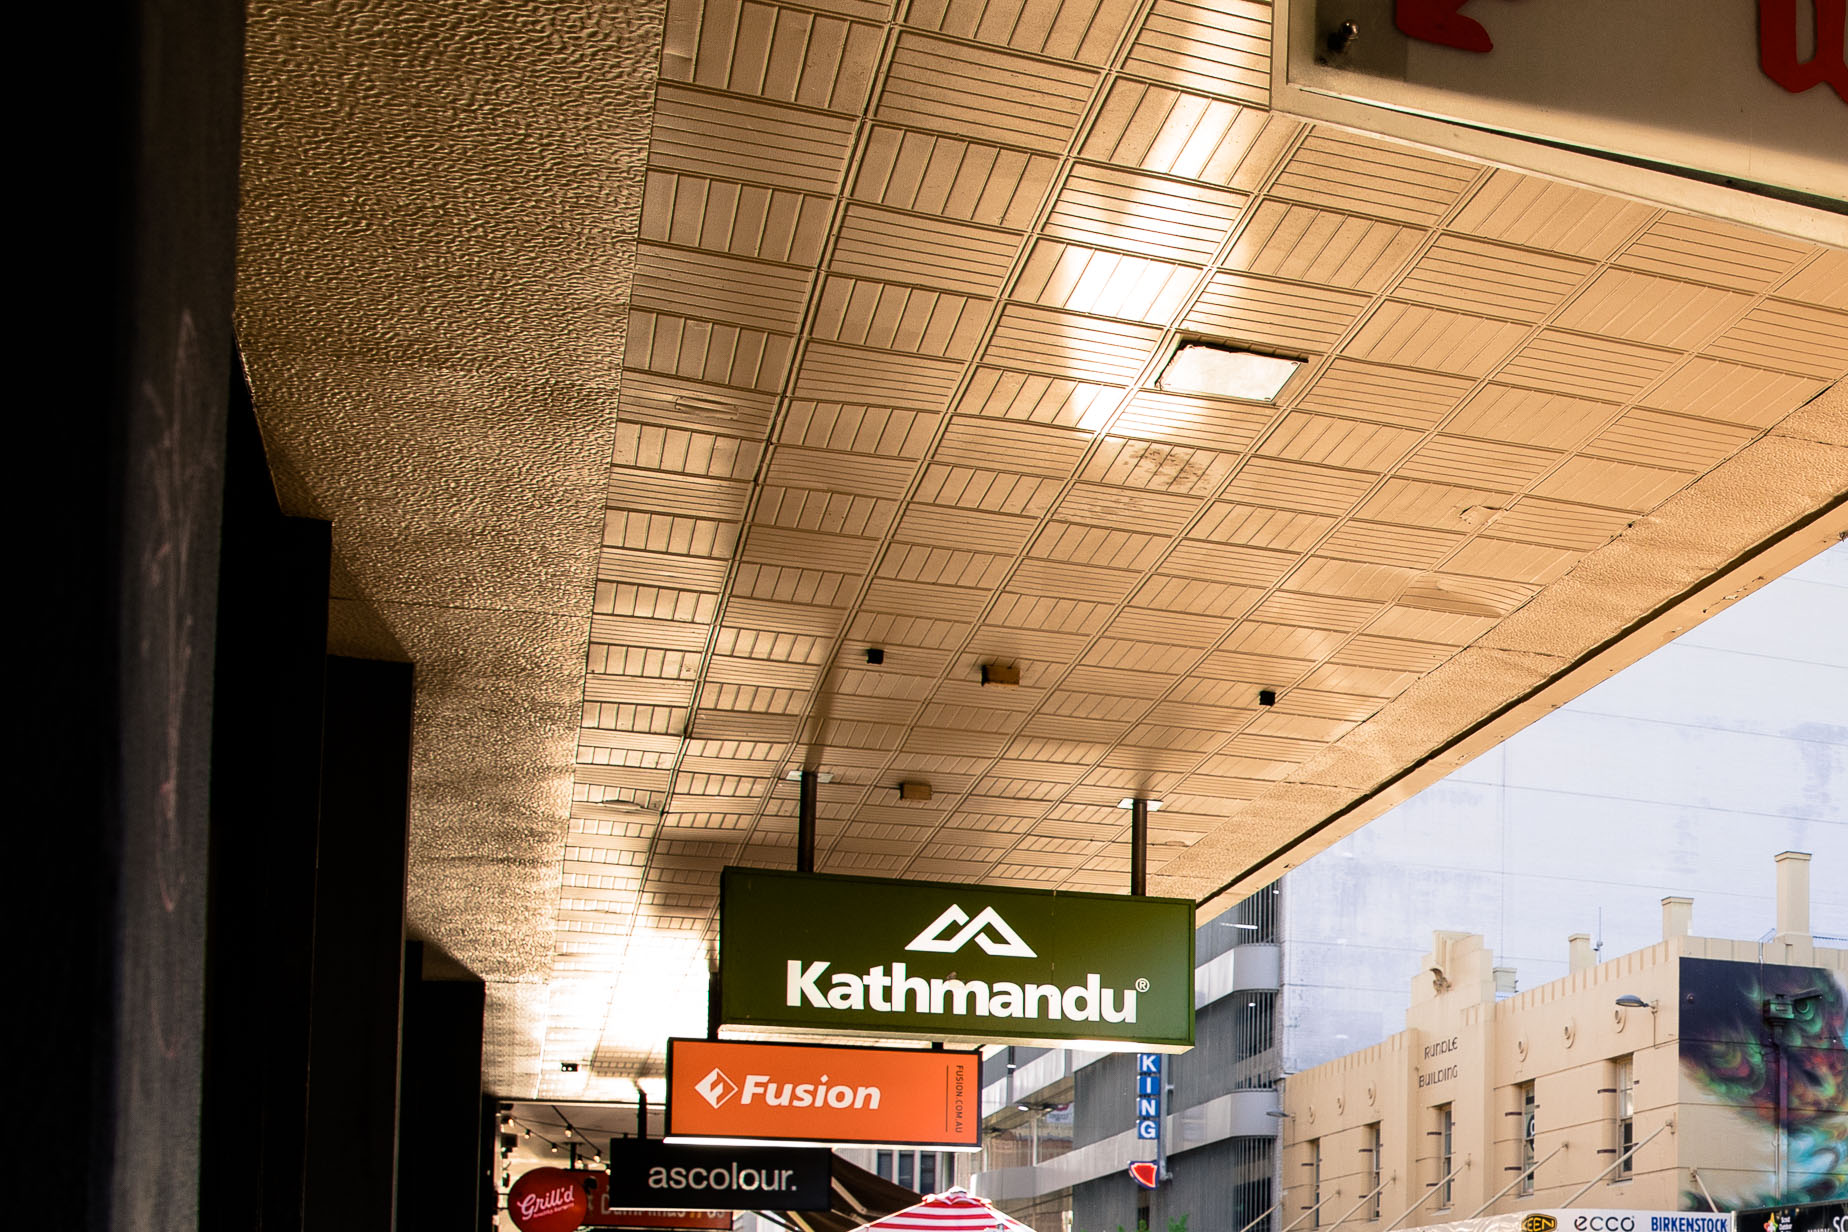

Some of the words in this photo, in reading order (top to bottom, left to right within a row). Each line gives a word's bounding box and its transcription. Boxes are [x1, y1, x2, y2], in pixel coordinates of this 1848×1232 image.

[1424, 1036, 1458, 1060] RUNDLE
[1418, 1064, 1458, 1088] BUILDING
[740, 1074, 881, 1110] Fusion
[517, 1185, 575, 1221] Grill'd
[1574, 1215, 1635, 1232] ecco
